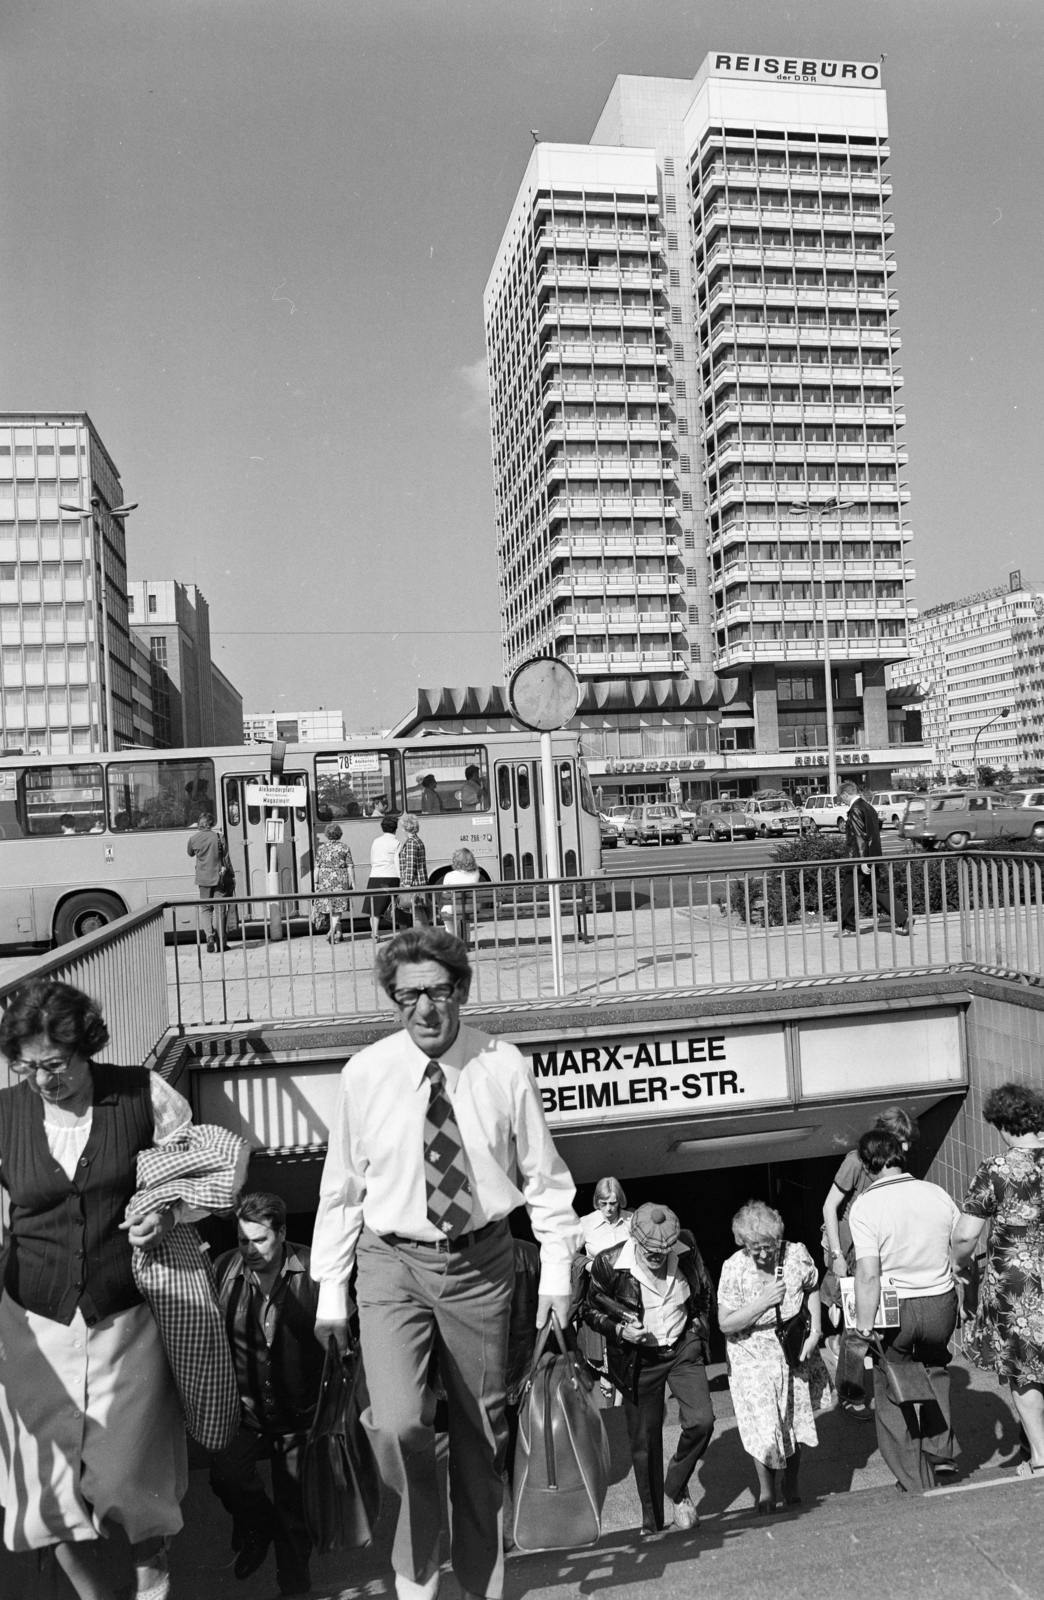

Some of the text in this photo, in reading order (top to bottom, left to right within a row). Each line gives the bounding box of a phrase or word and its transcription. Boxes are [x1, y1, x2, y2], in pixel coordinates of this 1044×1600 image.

[715, 55, 879, 80] REISEBÜRO
[794, 75, 817, 83] DDR
[532, 1036, 726, 1077] MARX-ALLEE
[539, 1070, 745, 1113] BEIMLER-STR.
